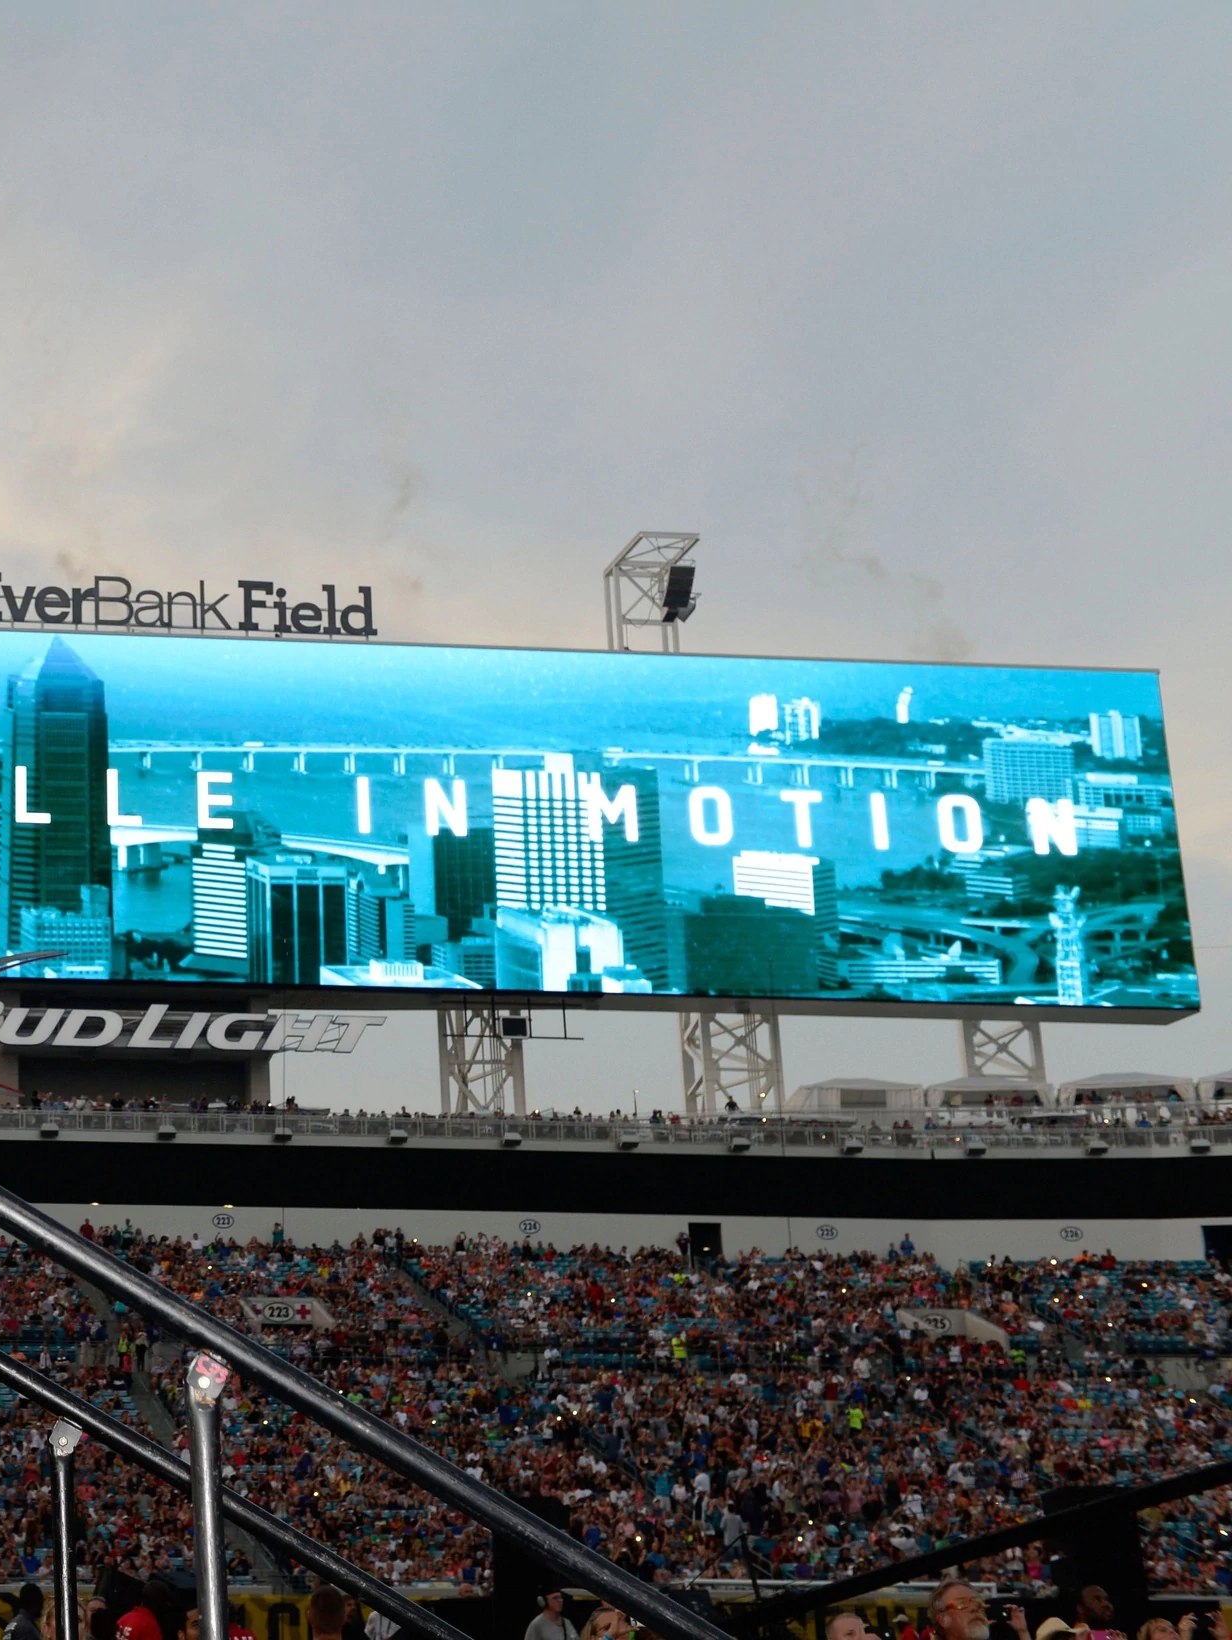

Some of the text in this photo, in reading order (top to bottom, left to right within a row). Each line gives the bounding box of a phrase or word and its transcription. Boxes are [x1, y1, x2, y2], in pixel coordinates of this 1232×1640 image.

[238, 579, 378, 636] Field
[355, 776, 468, 837] IN
[586, 784, 1079, 857] MOTION
[127, 1003, 388, 1054] LIGHT
[268, 1306, 290, 1318] 223
